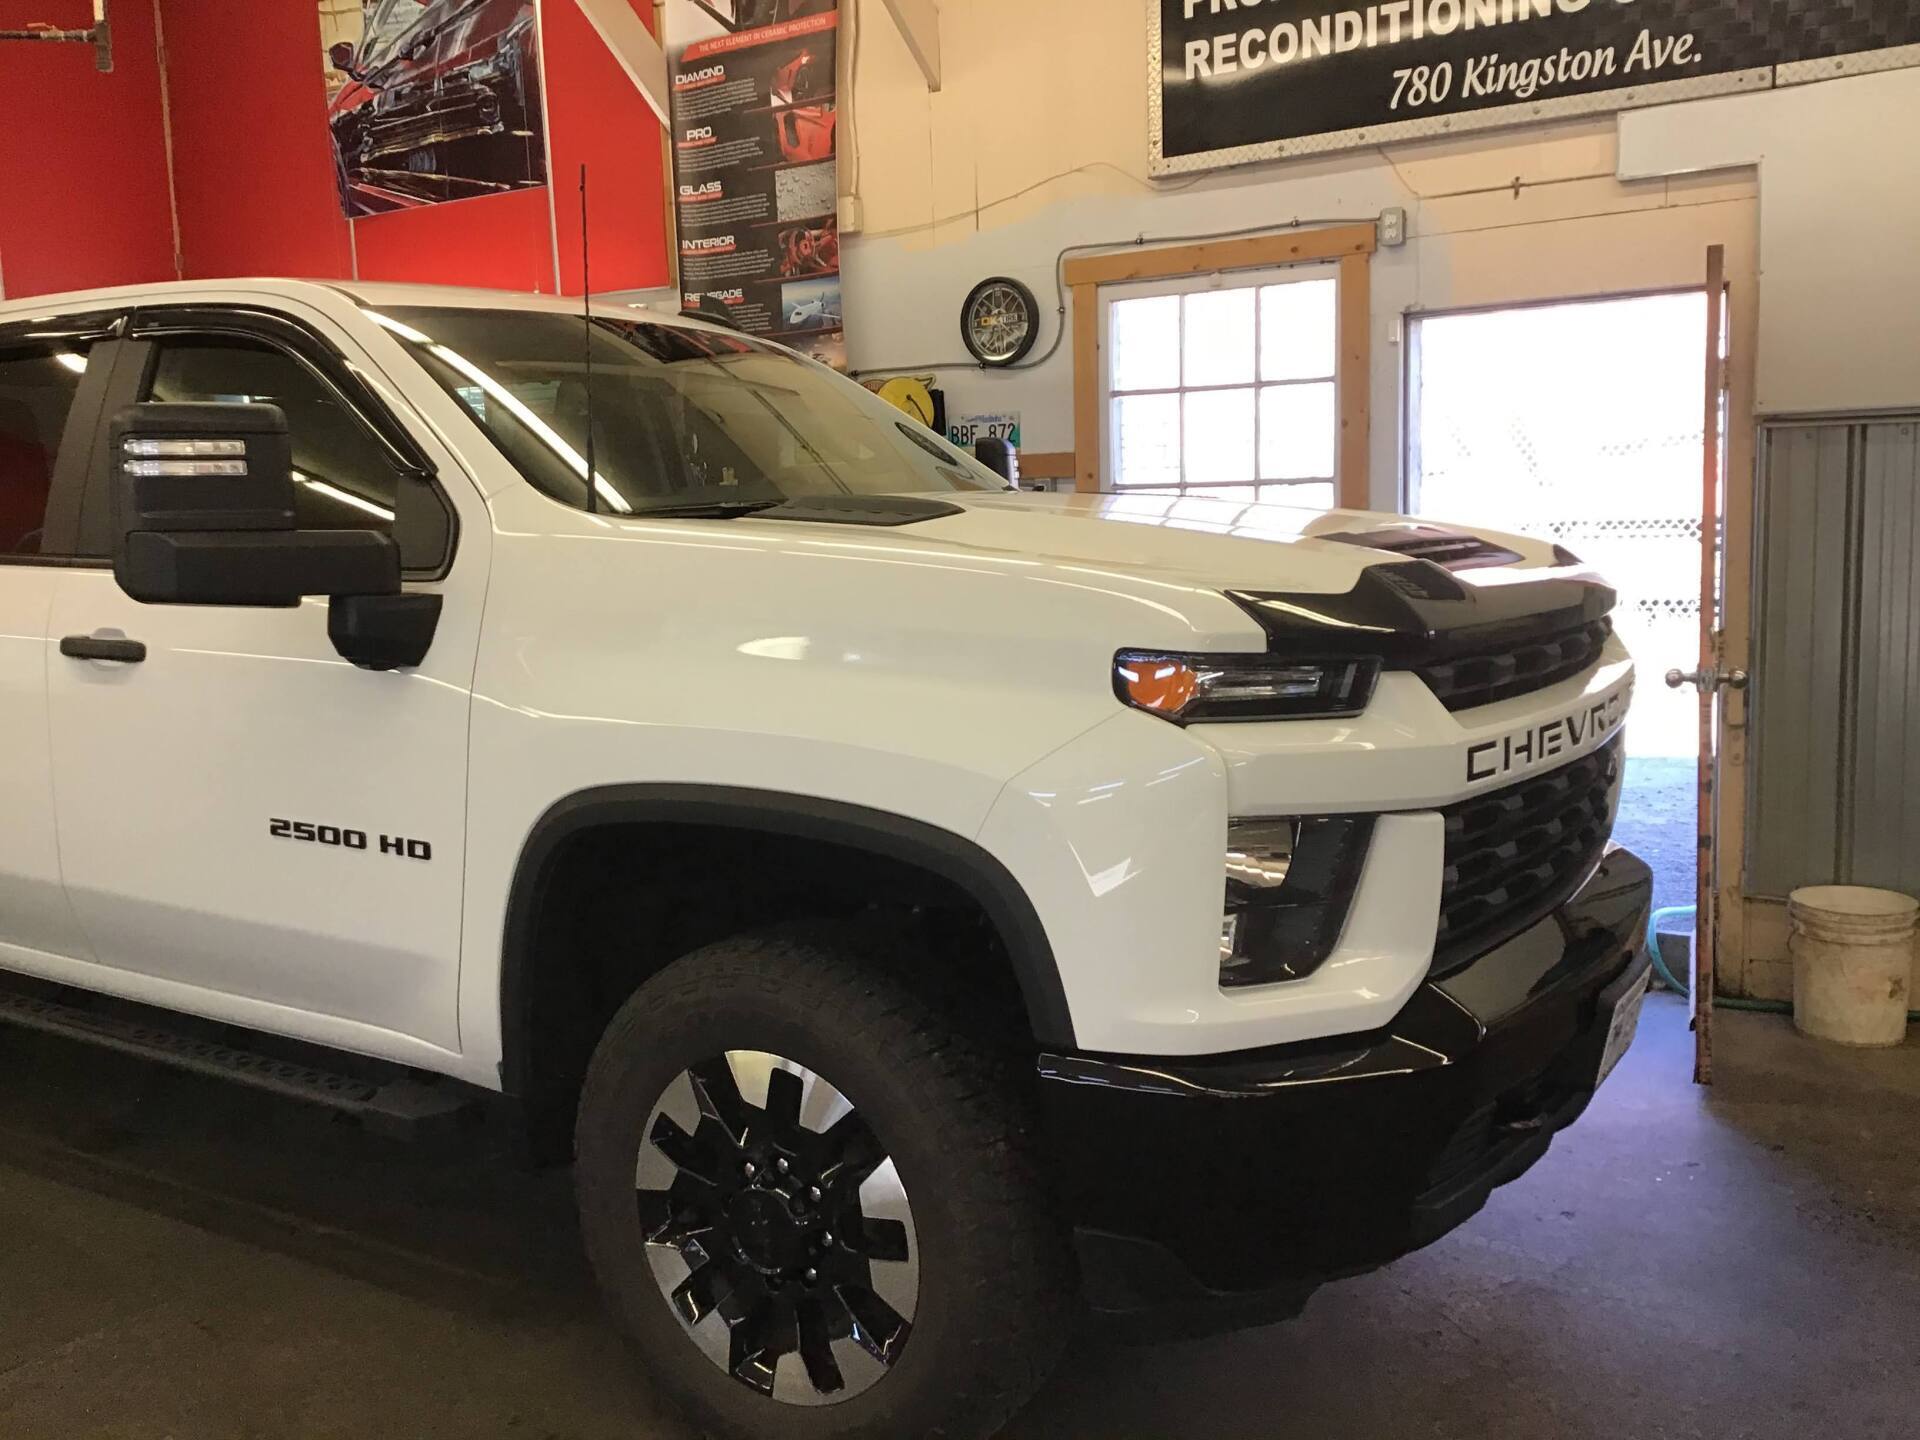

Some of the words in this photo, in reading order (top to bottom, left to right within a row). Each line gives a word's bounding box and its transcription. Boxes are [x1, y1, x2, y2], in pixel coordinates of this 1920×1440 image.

[726, 34, 752, 47] ELEMENT
[761, 26, 787, 39] CERAMIC
[788, 16, 826, 32] PROTECTION
[675, 64, 724, 85] DIAMOND
[1389, 62, 1453, 110] 780
[1462, 45, 1616, 98] Kingston
[1624, 29, 1702, 73] Ave.
[686, 126, 712, 141] PRO
[680, 180, 722, 196] GLASS
[682, 235, 735, 249] INTERIOR
[684, 288, 743, 302] REEGADE
[269, 817, 368, 850] 2500
[379, 834, 432, 861] HD
